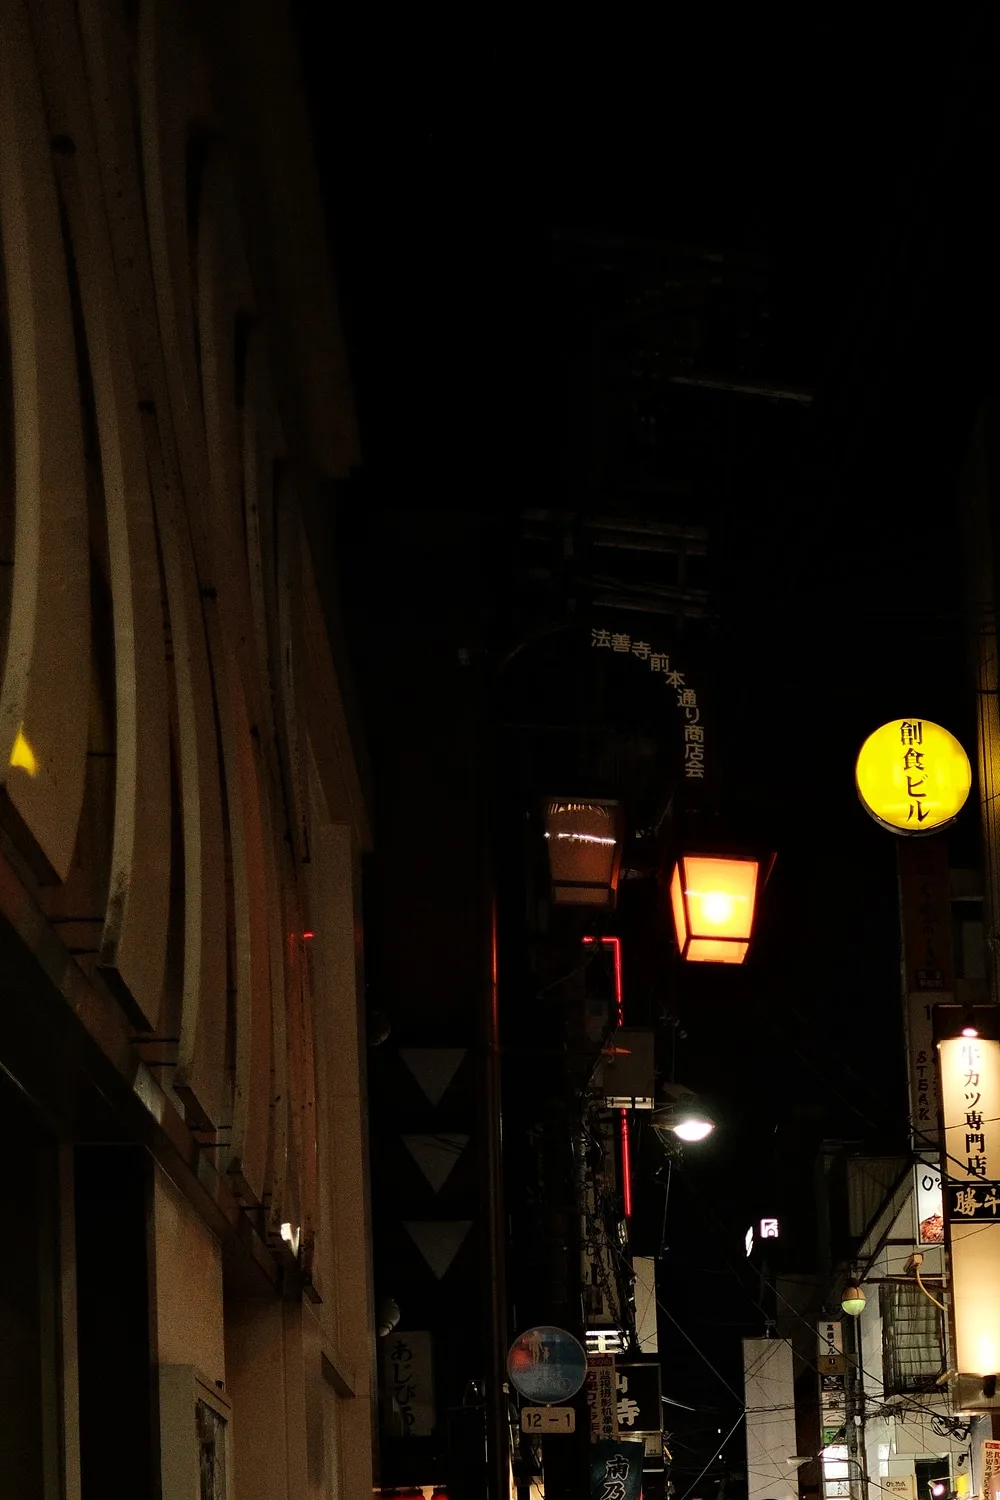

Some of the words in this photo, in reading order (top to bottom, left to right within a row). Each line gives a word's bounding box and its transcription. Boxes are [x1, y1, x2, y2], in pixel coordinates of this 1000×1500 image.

[590, 628, 705, 778] 法善寺前本通り商店会
[900, 721, 931, 823] 創食ビル
[960, 1044, 987, 1176] 牛カツ専門店
